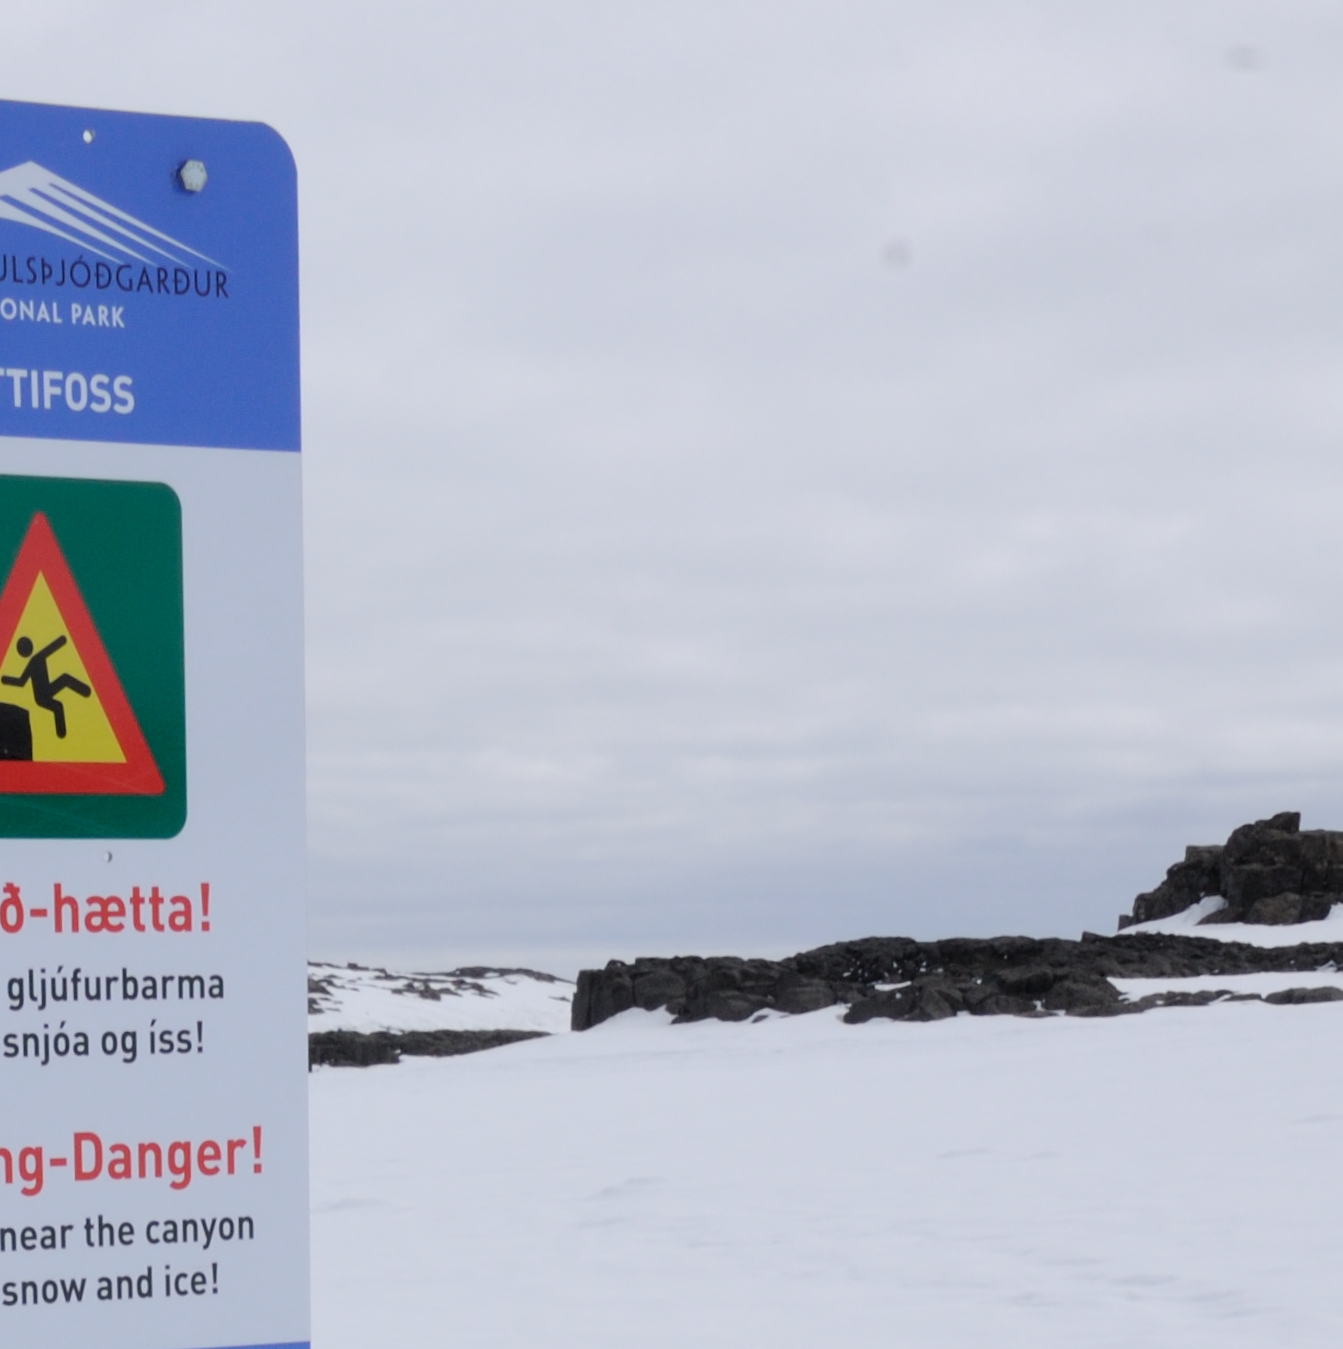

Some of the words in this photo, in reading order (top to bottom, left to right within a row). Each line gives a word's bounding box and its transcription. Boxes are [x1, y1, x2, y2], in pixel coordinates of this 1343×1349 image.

[71, 305, 126, 328] PARK
[7, 967, 225, 1012] gljúfurbarma
[2, 1022, 90, 1065] snjóa
[101, 1028, 138, 1062] og
[149, 1020, 205, 1054] íss!
[0, 1218, 74, 1253] near
[84, 1214, 136, 1247] the
[145, 1213, 255, 1253] canyon
[2, 1273, 87, 1306] snow
[96, 1266, 154, 1300] and
[164, 1263, 220, 1297] ice!
